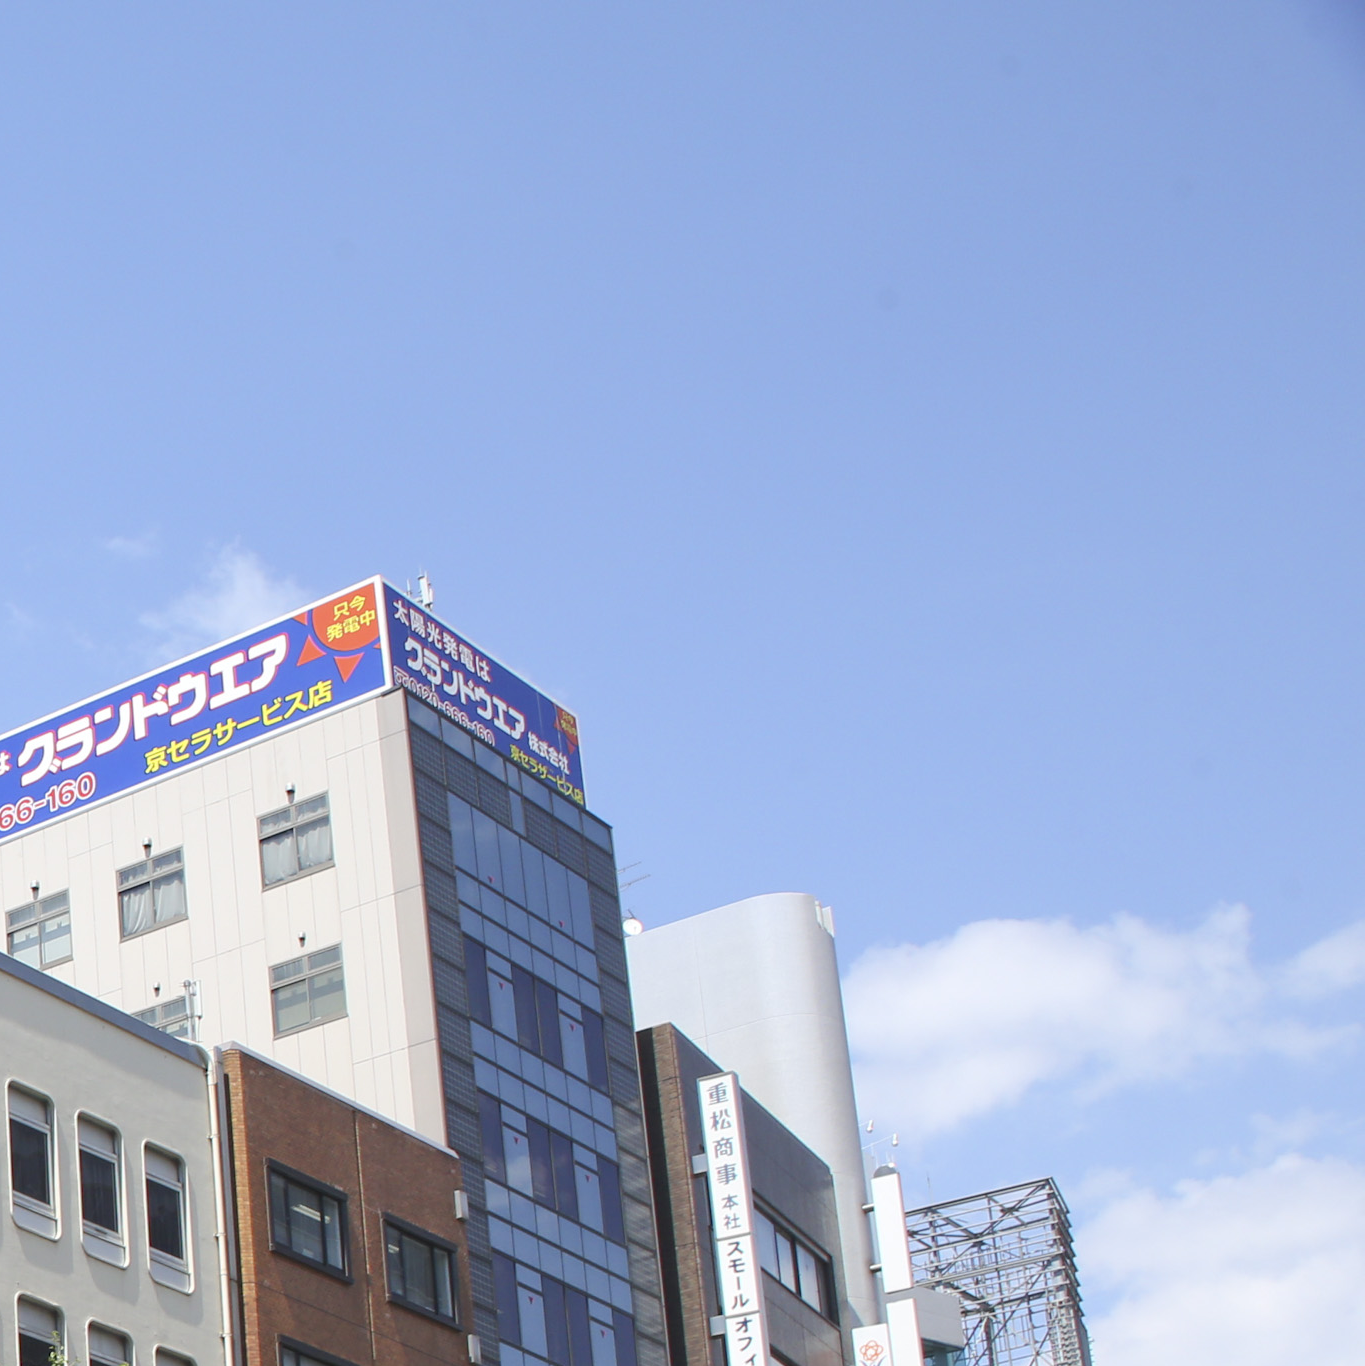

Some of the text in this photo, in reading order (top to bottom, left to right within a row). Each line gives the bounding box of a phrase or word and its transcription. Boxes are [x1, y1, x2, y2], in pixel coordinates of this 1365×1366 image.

[325, 607, 376, 643] 発電中
[332, 594, 367, 621] 只今
[392, 599, 492, 682] 太陽光発電は
[17, 632, 289, 788] グランドウエア
[142, 680, 334, 776] 京セラサービス店
[404, 636, 571, 775] グランドウエア 株式会社
[509, 744, 584, 806] 京セラサービス店
[706, 1081, 742, 1231] 重松商事 本社
[726, 1240, 750, 1310] スモール
